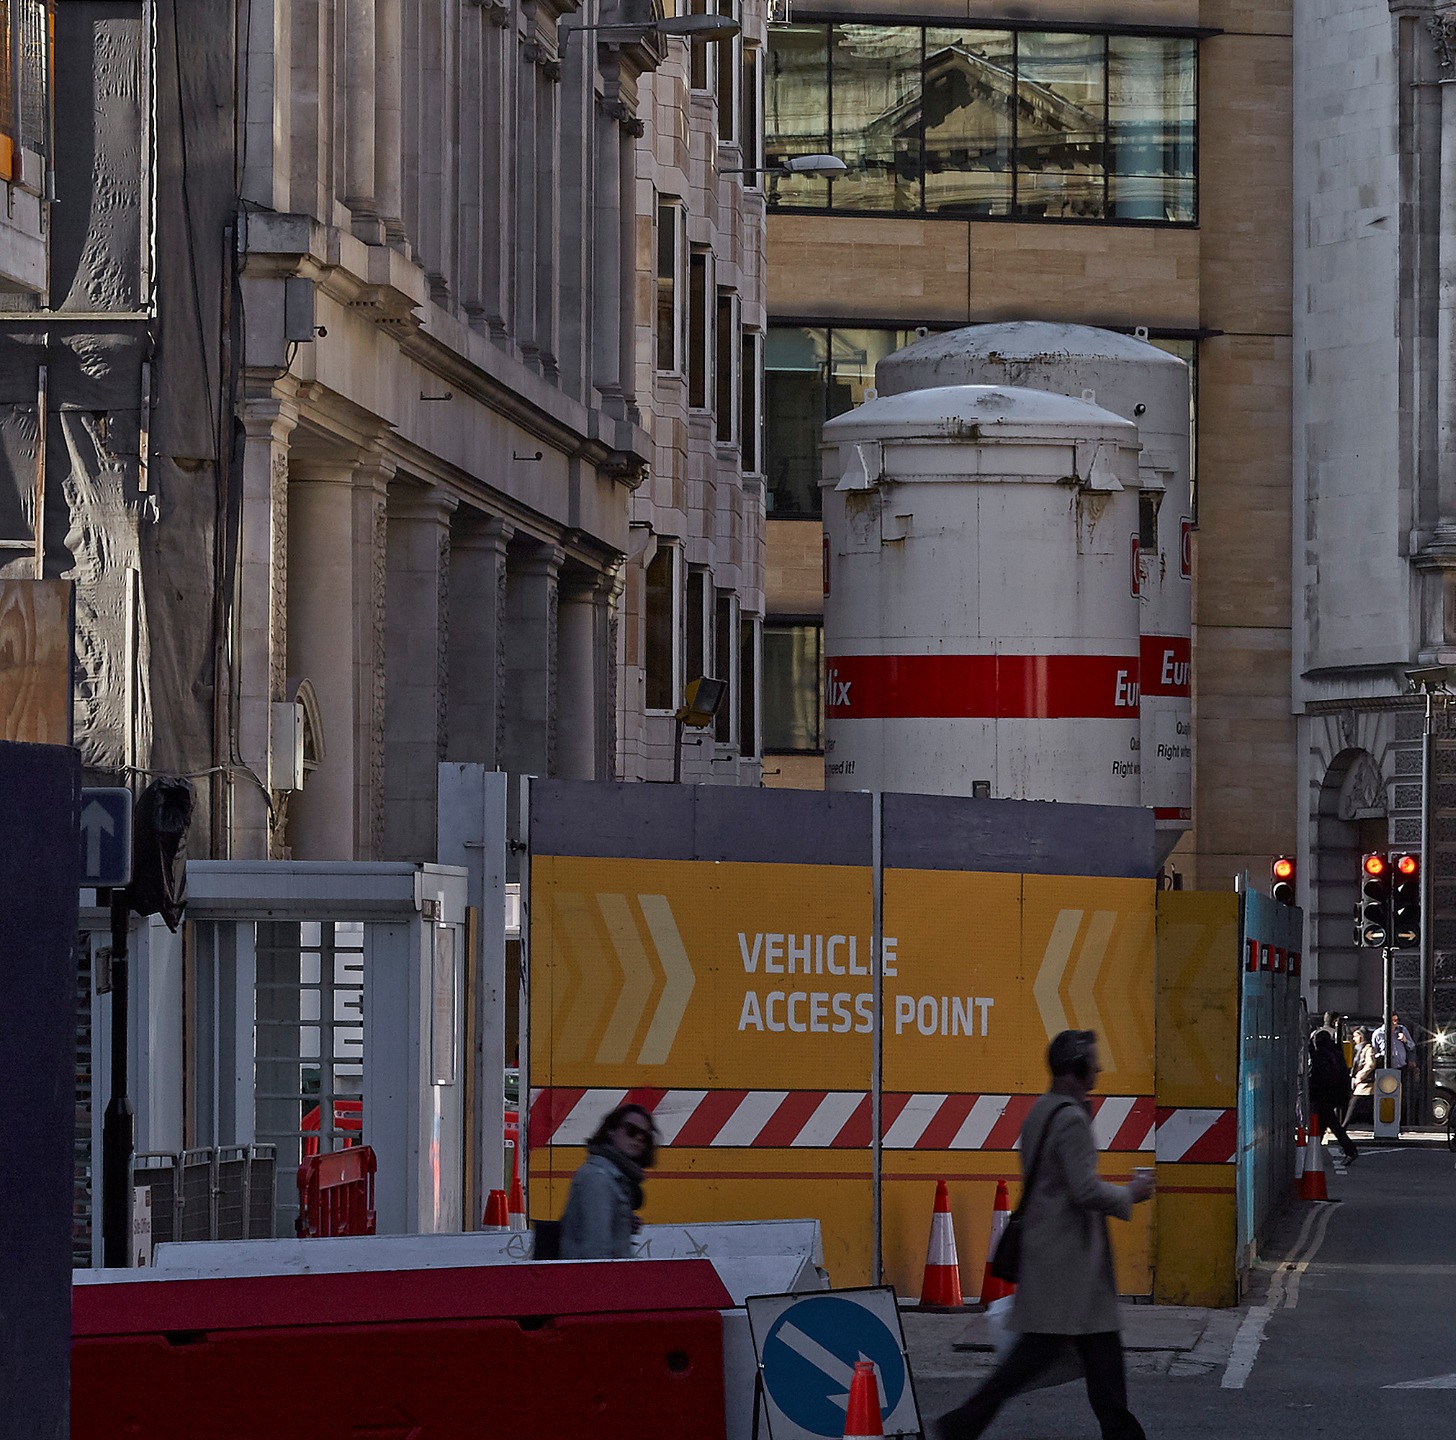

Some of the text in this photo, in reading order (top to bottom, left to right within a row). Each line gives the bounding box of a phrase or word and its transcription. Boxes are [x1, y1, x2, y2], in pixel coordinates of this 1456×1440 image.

[1157, 744, 1180, 761] Right
[1112, 761, 1134, 778] Right
[737, 932, 898, 977] VEHICLE
[737, 991, 995, 1037] ACCESS POINT
